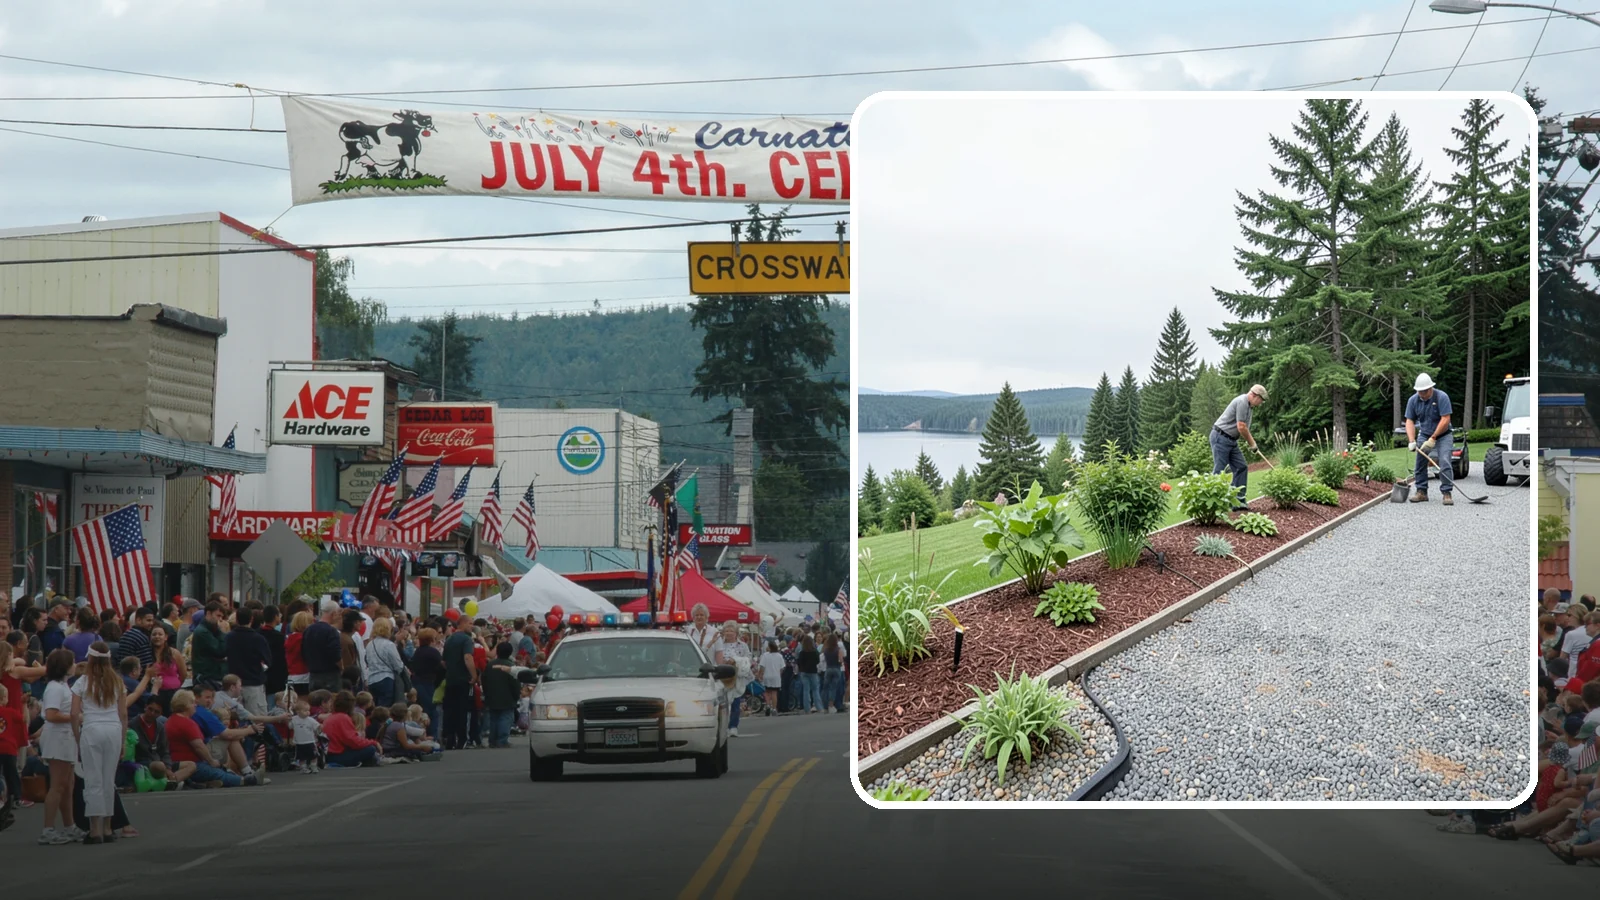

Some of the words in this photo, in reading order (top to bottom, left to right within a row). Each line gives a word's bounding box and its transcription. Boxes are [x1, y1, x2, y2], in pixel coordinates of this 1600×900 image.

[694, 121, 850, 149] Carnat
[481, 141, 605, 192] JULY
[632, 150, 746, 197] 4th.
[697, 254, 850, 280] CROSSWA
[282, 379, 374, 420] ACE
[405, 408, 453, 422] CEDAR
[283, 421, 371, 437] Hardware
[416, 428, 477, 447] Coca-Cola
[353, 466, 385, 480] Simpl
[83, 485, 94, 494] St.
[95, 485, 124, 494] Vincent
[126, 486, 136, 495] de
[137, 486, 155, 495] Paul
[81, 503, 153, 522] THT
[213, 516, 330, 535] HARDARE
[688, 526, 741, 535] CRNATION
[699, 535, 730, 543] GLASS
